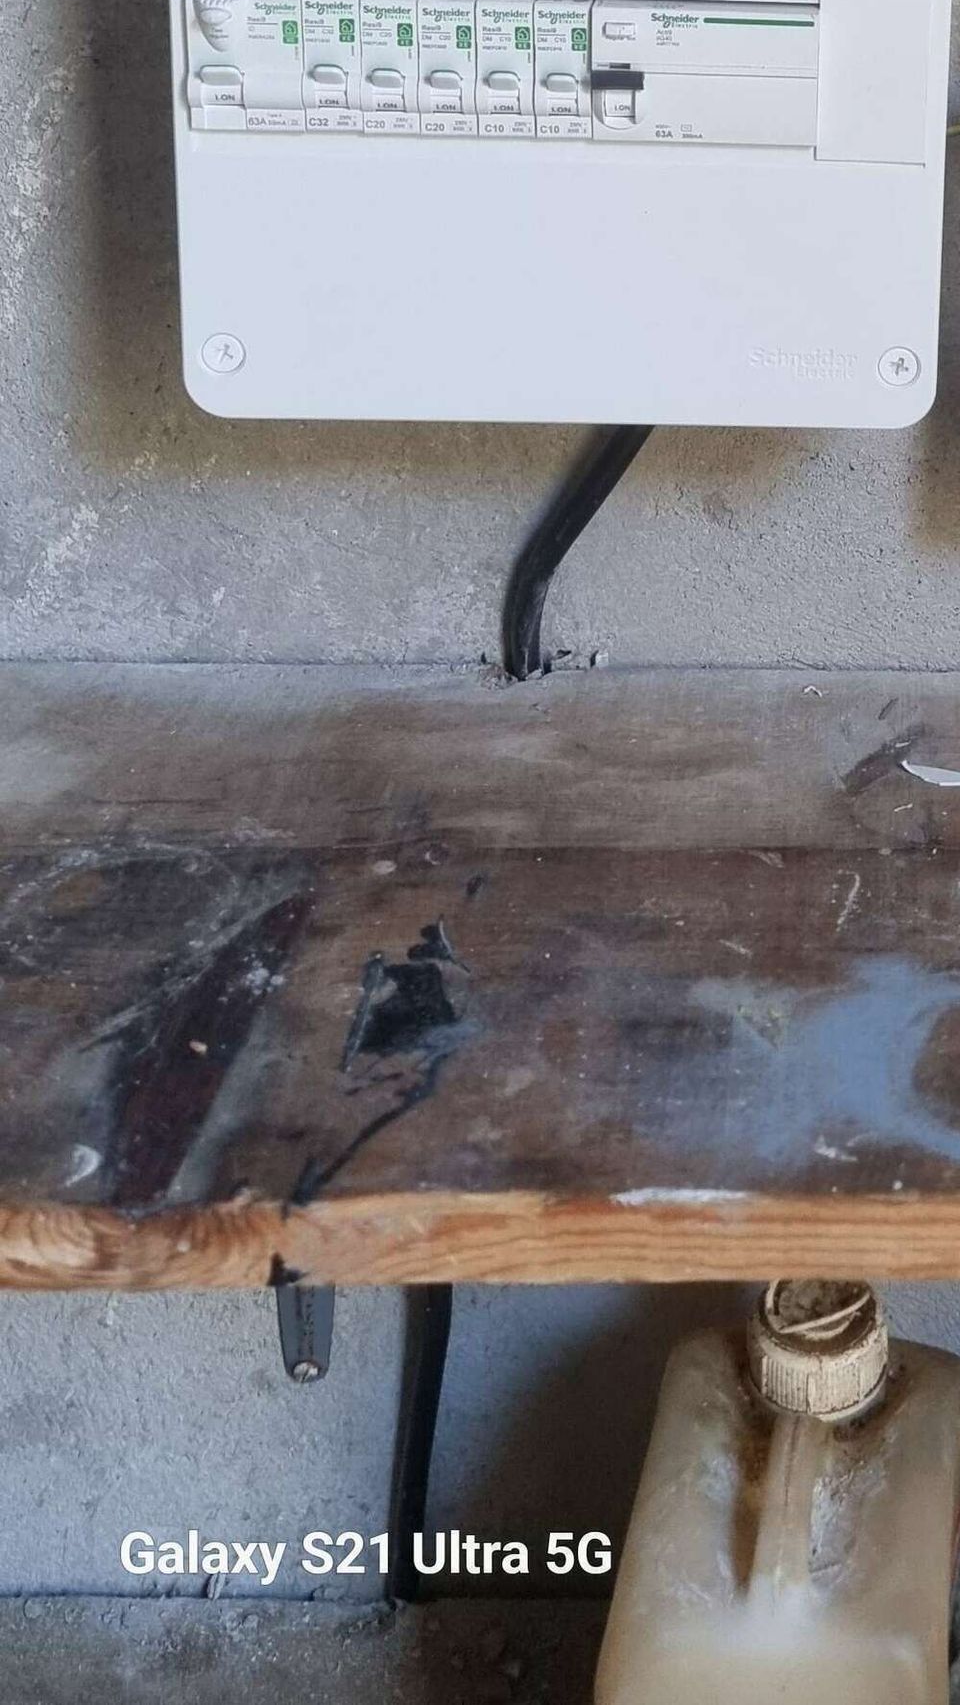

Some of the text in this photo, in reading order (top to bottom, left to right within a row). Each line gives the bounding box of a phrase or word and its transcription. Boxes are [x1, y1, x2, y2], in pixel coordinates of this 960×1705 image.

[304, 1, 354, 15] Schneider
[363, 5, 412, 20] Schneider
[422, 8, 471, 22] Schneider
[481, 9, 530, 24] Schneider
[537, 10, 586, 25] Schneider
[650, 13, 700, 29] Schneider
[308, 117, 329, 127] C32
[365, 120, 386, 130] C20
[424, 122, 445, 132] C20
[484, 124, 505, 134] C10
[539, 125, 560, 135] C10
[655, 130, 673, 139] 63A
